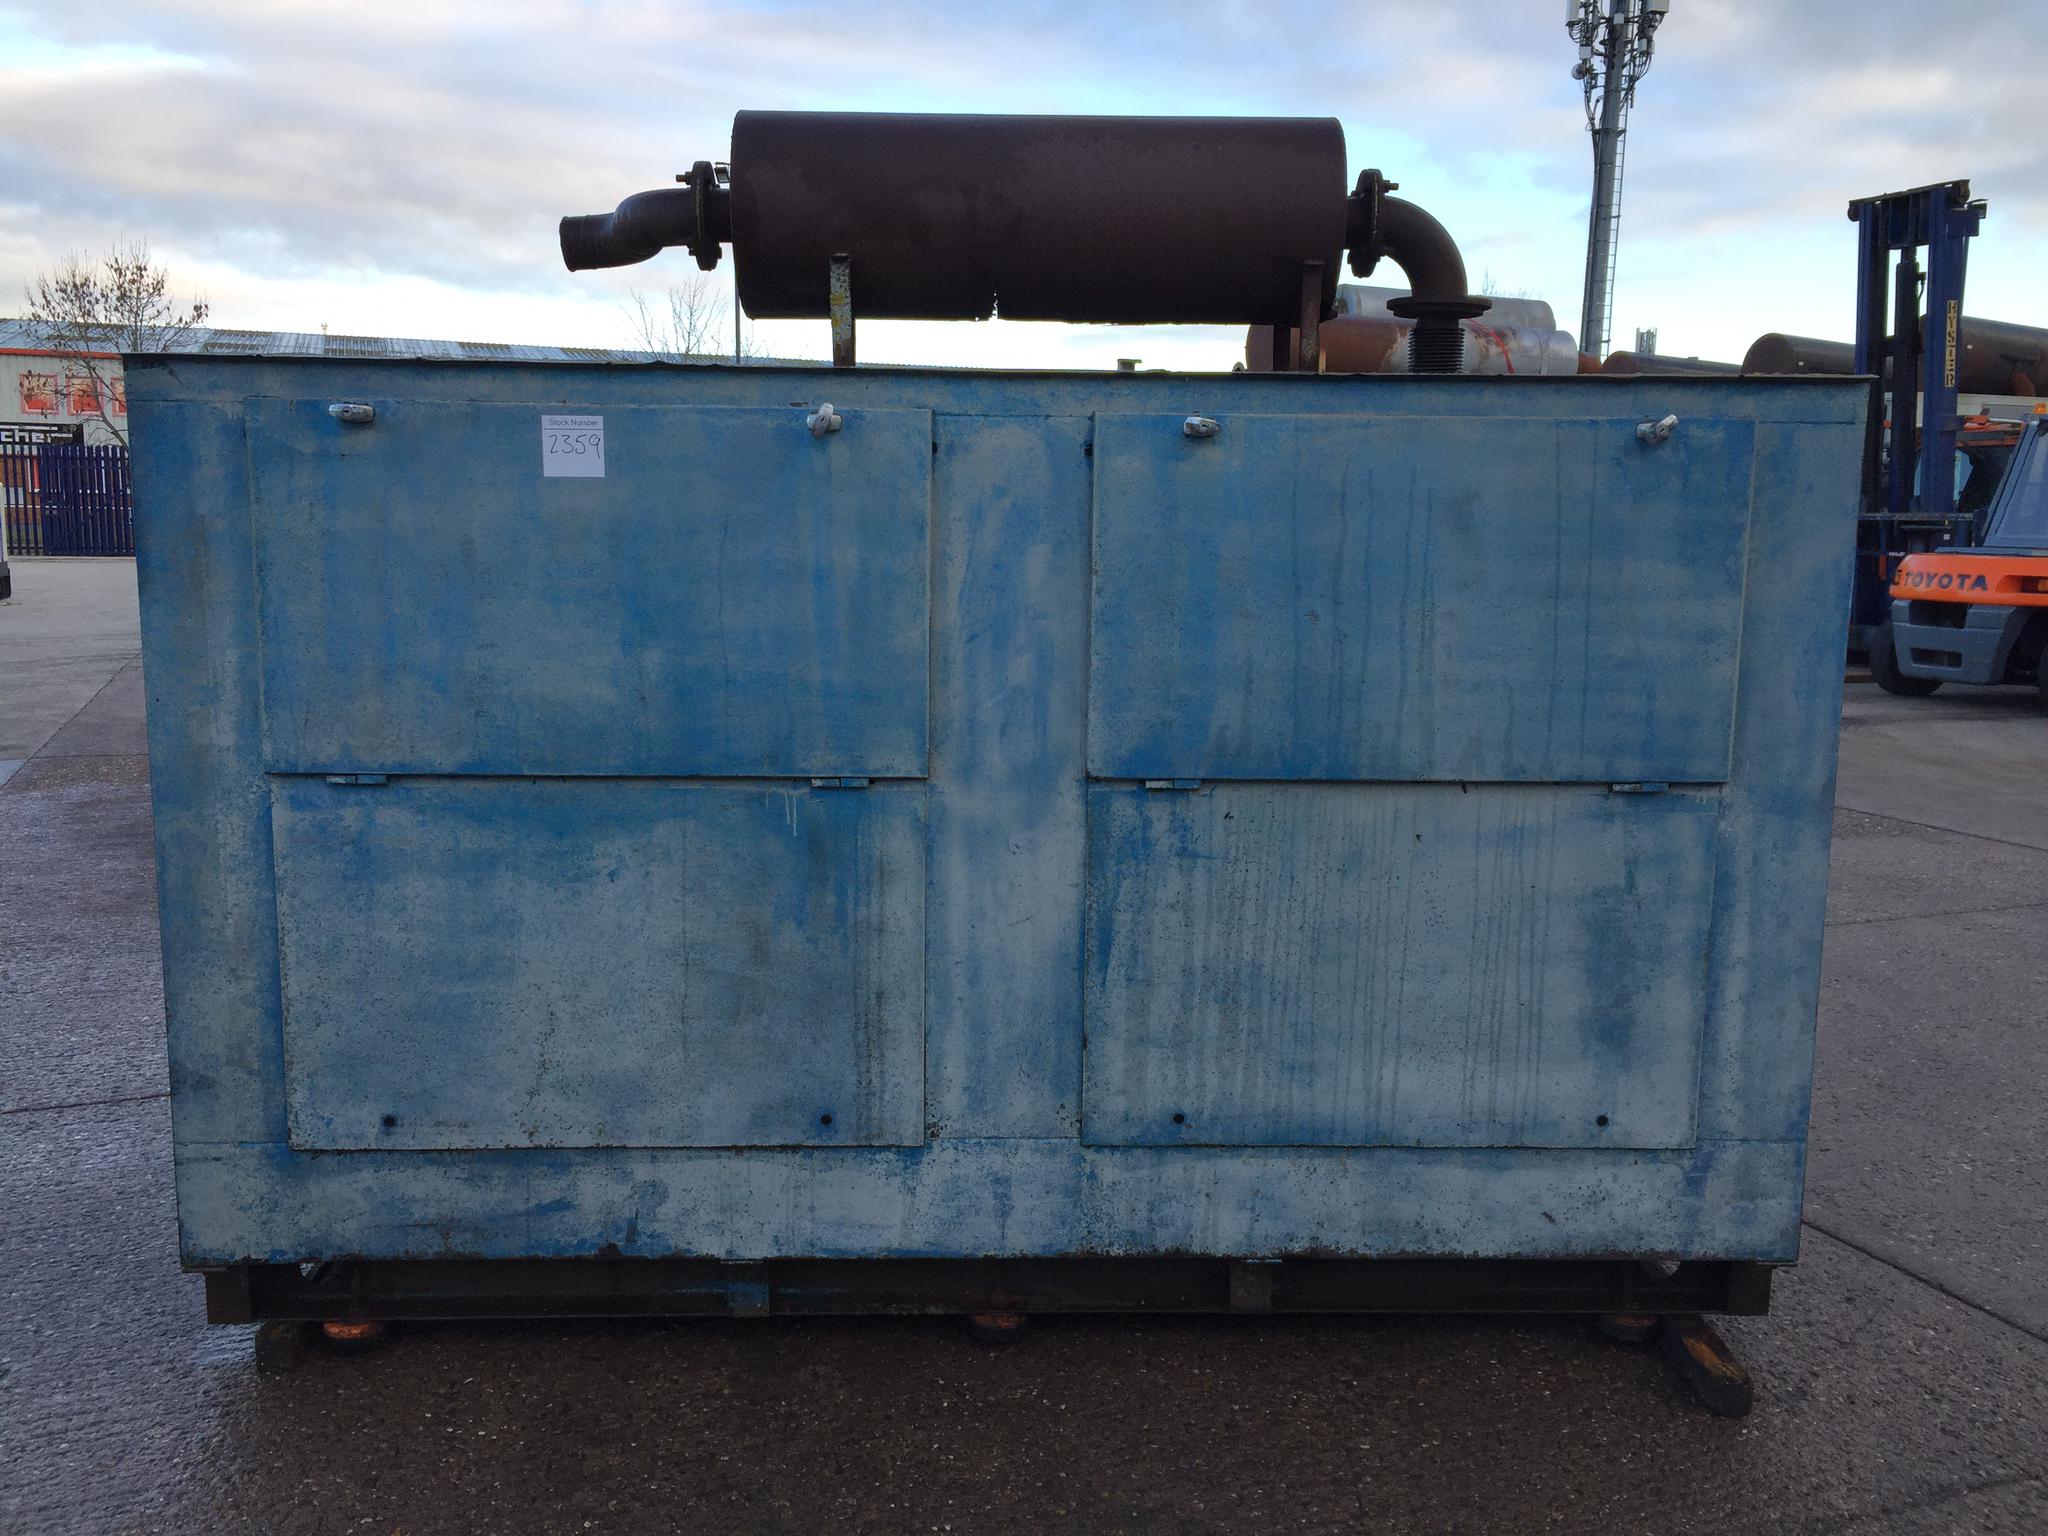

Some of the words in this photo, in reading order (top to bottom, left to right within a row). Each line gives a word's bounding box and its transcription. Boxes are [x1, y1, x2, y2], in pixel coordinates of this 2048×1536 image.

[1945, 301, 1957, 386] HYSTER
[548, 418, 569, 426] Stock
[548, 433, 601, 459] 2359
[1904, 570, 1988, 592] TOYOTA
